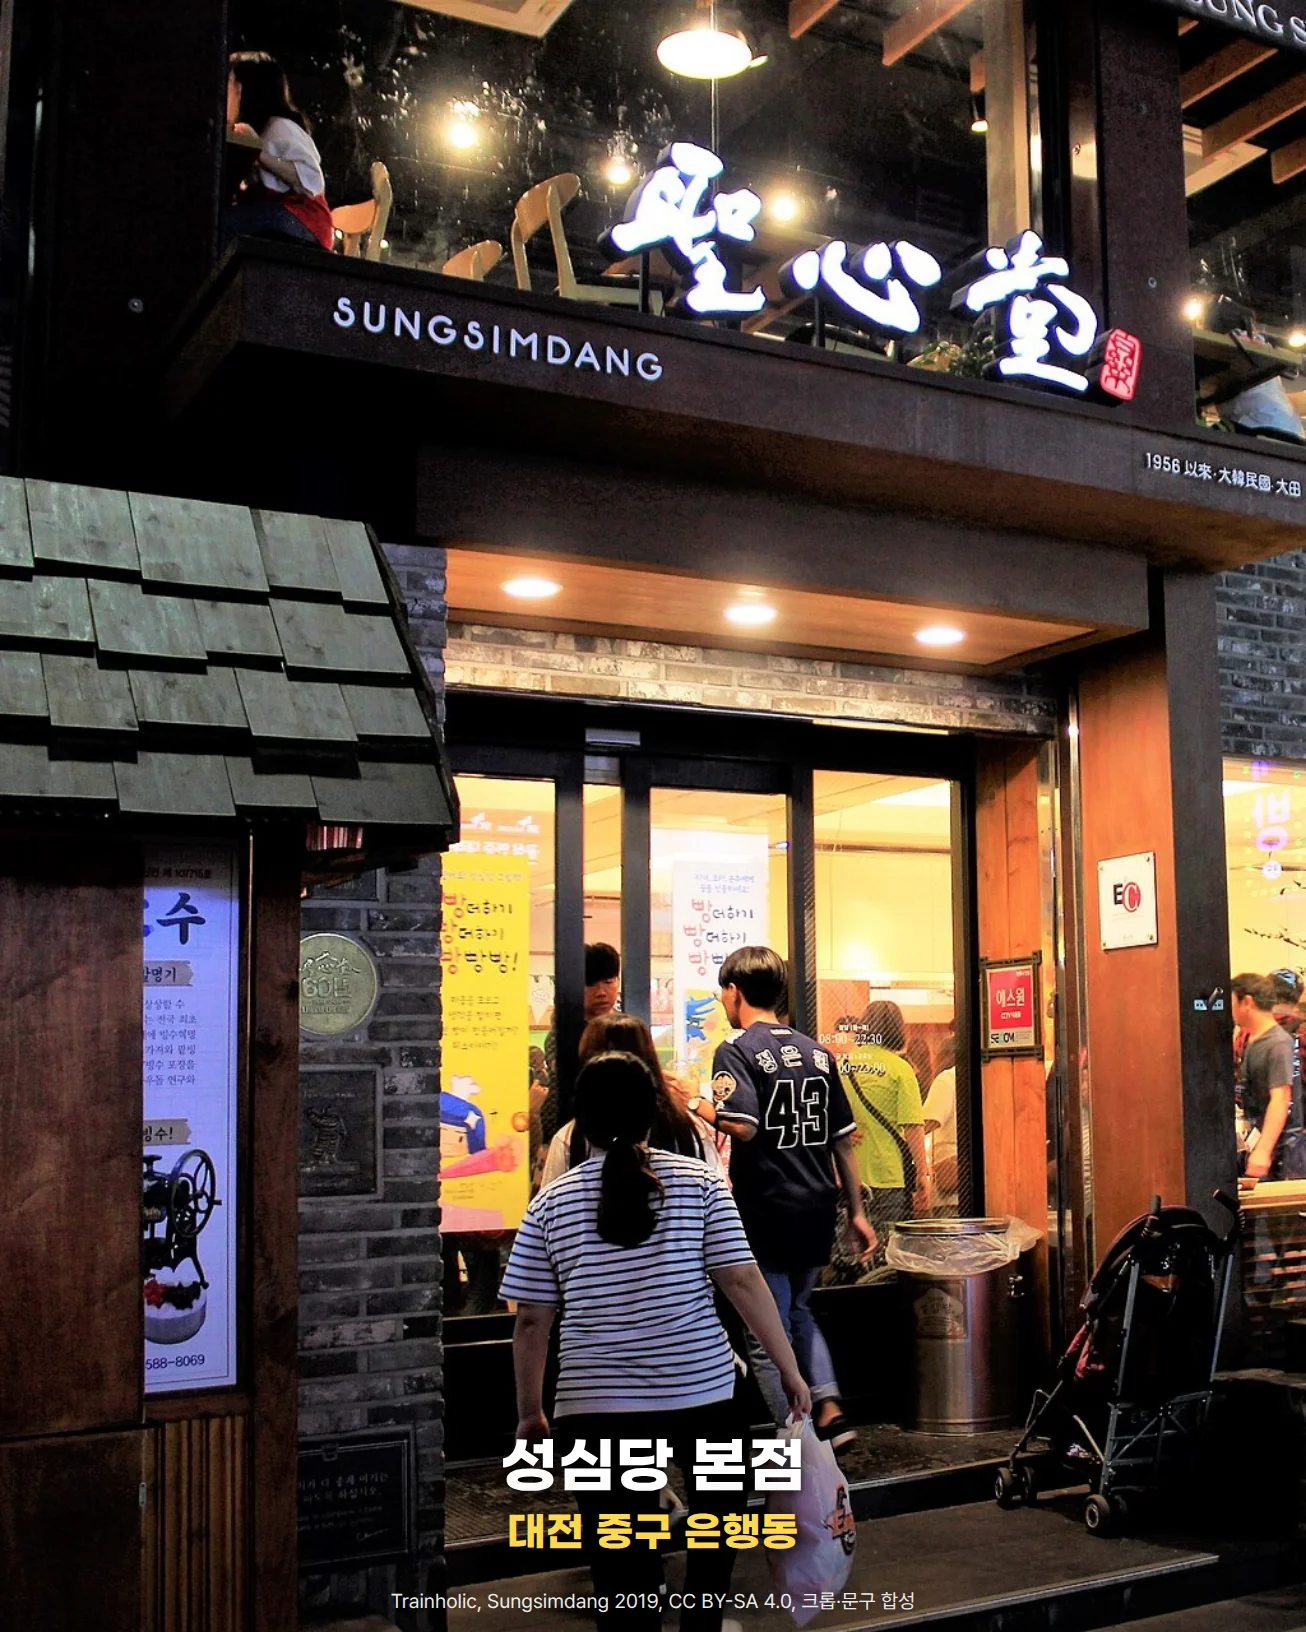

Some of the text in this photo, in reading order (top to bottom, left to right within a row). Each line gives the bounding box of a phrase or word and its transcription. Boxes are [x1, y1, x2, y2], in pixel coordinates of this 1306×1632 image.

[608, 141, 1098, 392] 聖心堂
[333, 296, 663, 381] SUNGSIMDANG
[1145, 452, 1181, 474] 1956
[144, 891, 206, 946] 수
[996, 987, 1025, 1008] 에스원
[765, 1075, 830, 1150] 43
